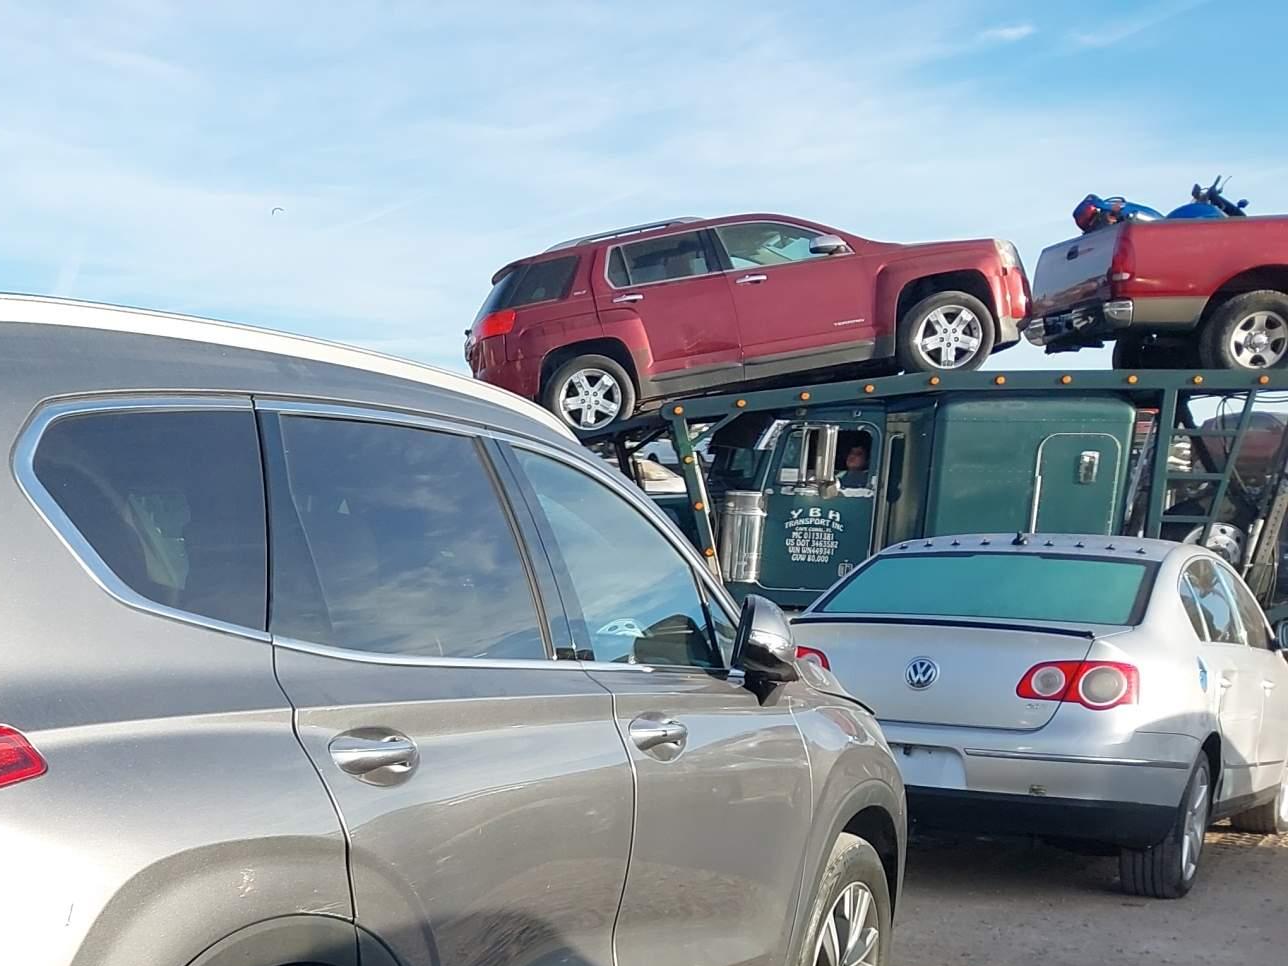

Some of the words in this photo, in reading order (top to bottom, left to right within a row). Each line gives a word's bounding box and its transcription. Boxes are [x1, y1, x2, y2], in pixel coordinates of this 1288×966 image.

[784, 518, 831, 529] TRANSPORT
[792, 531, 803, 539] MC
[786, 538, 795, 546] US
[796, 539, 810, 547] DOT
